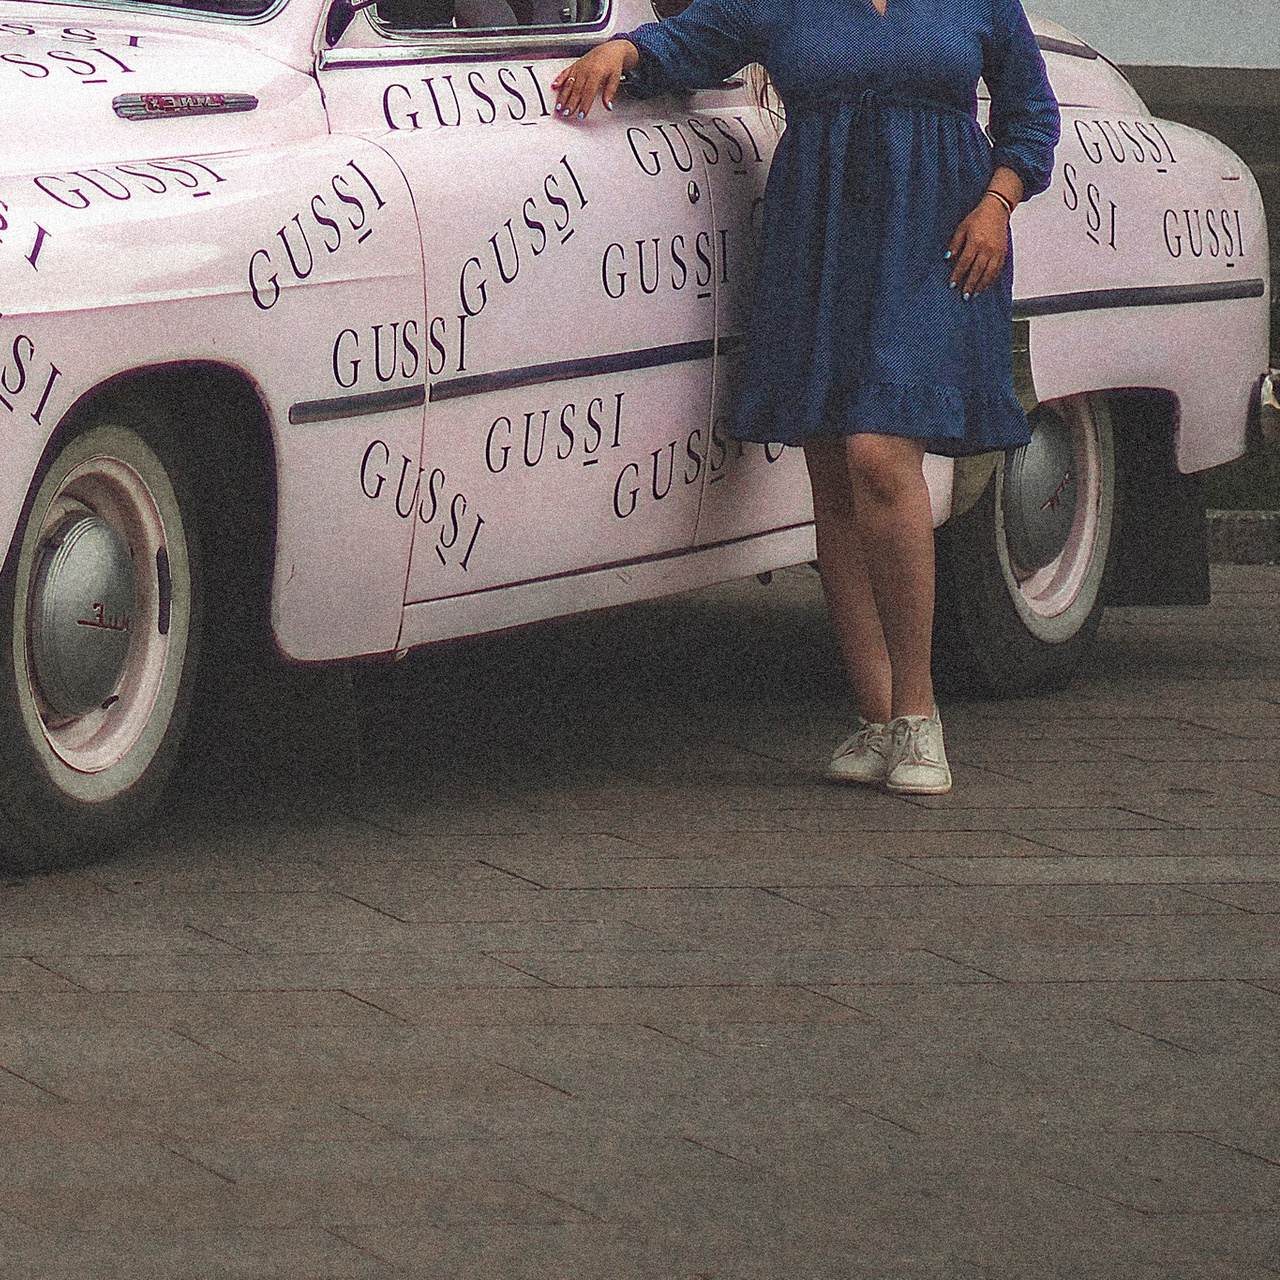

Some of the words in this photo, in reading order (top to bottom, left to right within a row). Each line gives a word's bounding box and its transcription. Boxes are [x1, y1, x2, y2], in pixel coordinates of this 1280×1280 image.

[381, 65, 551, 130] GUSSI
[626, 116, 763, 177] GUSSI
[1074, 120, 1177, 173] GUSSI
[33, 158, 227, 210] GUSSI
[246, 159, 387, 311] GUSSI
[459, 154, 589, 318] GUSSI
[601, 229, 730, 300] GUSSI
[1163, 209, 1245, 268] GUSSI
[331, 315, 469, 389] GUSSI
[484, 392, 626, 475] GUSSI
[359, 439, 487, 572] GUSSI
